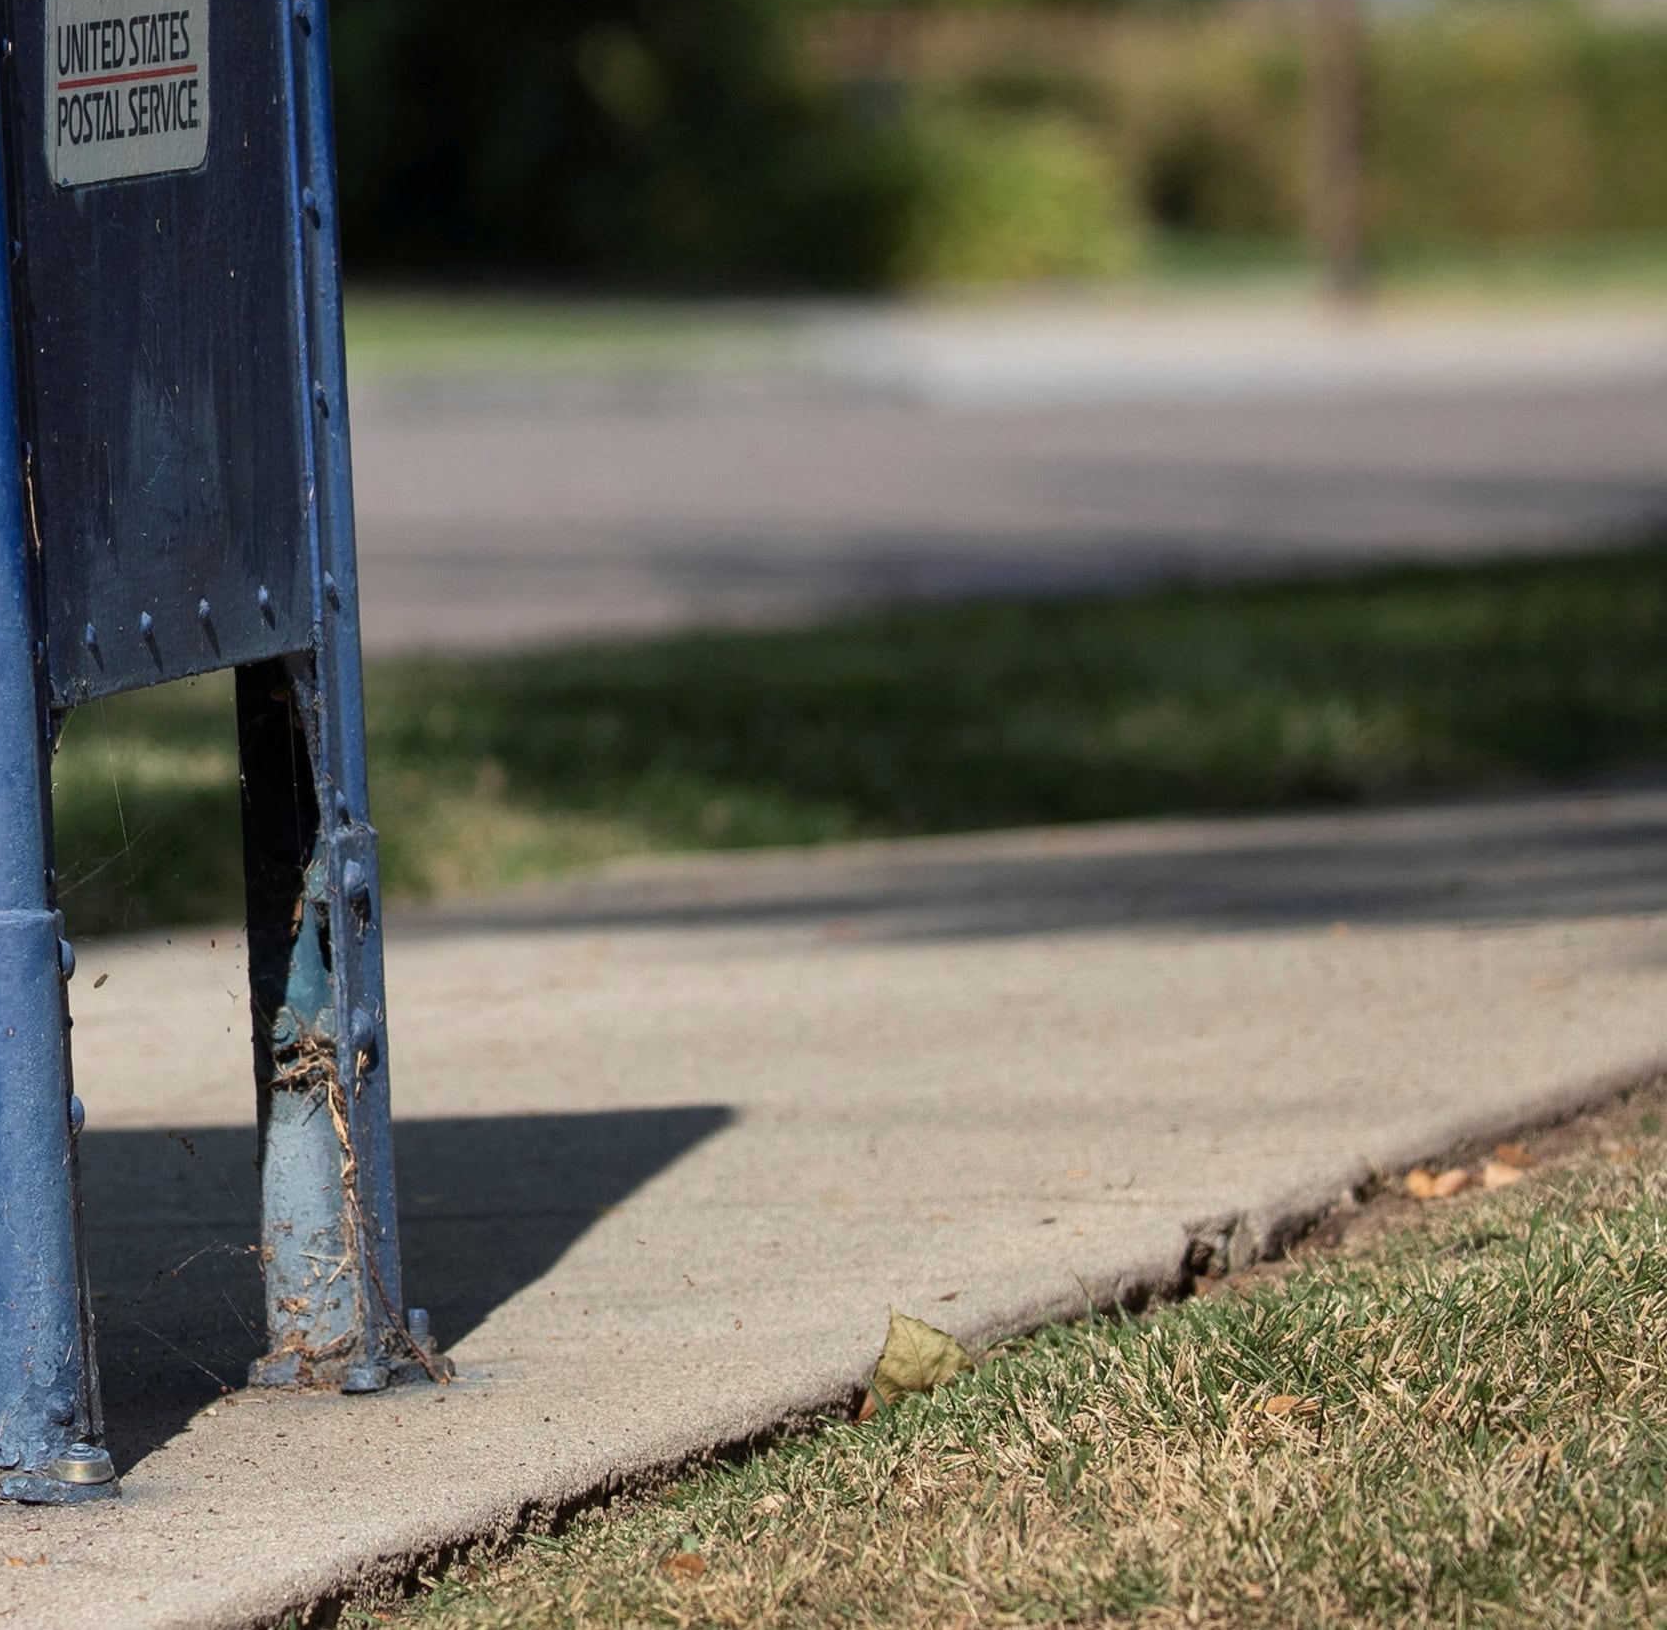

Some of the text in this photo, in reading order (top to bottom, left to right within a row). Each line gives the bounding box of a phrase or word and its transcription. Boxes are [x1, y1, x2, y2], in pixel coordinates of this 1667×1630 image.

[58, 10, 190, 76] UNITED STATES
[58, 89, 125, 147] POSTAL
